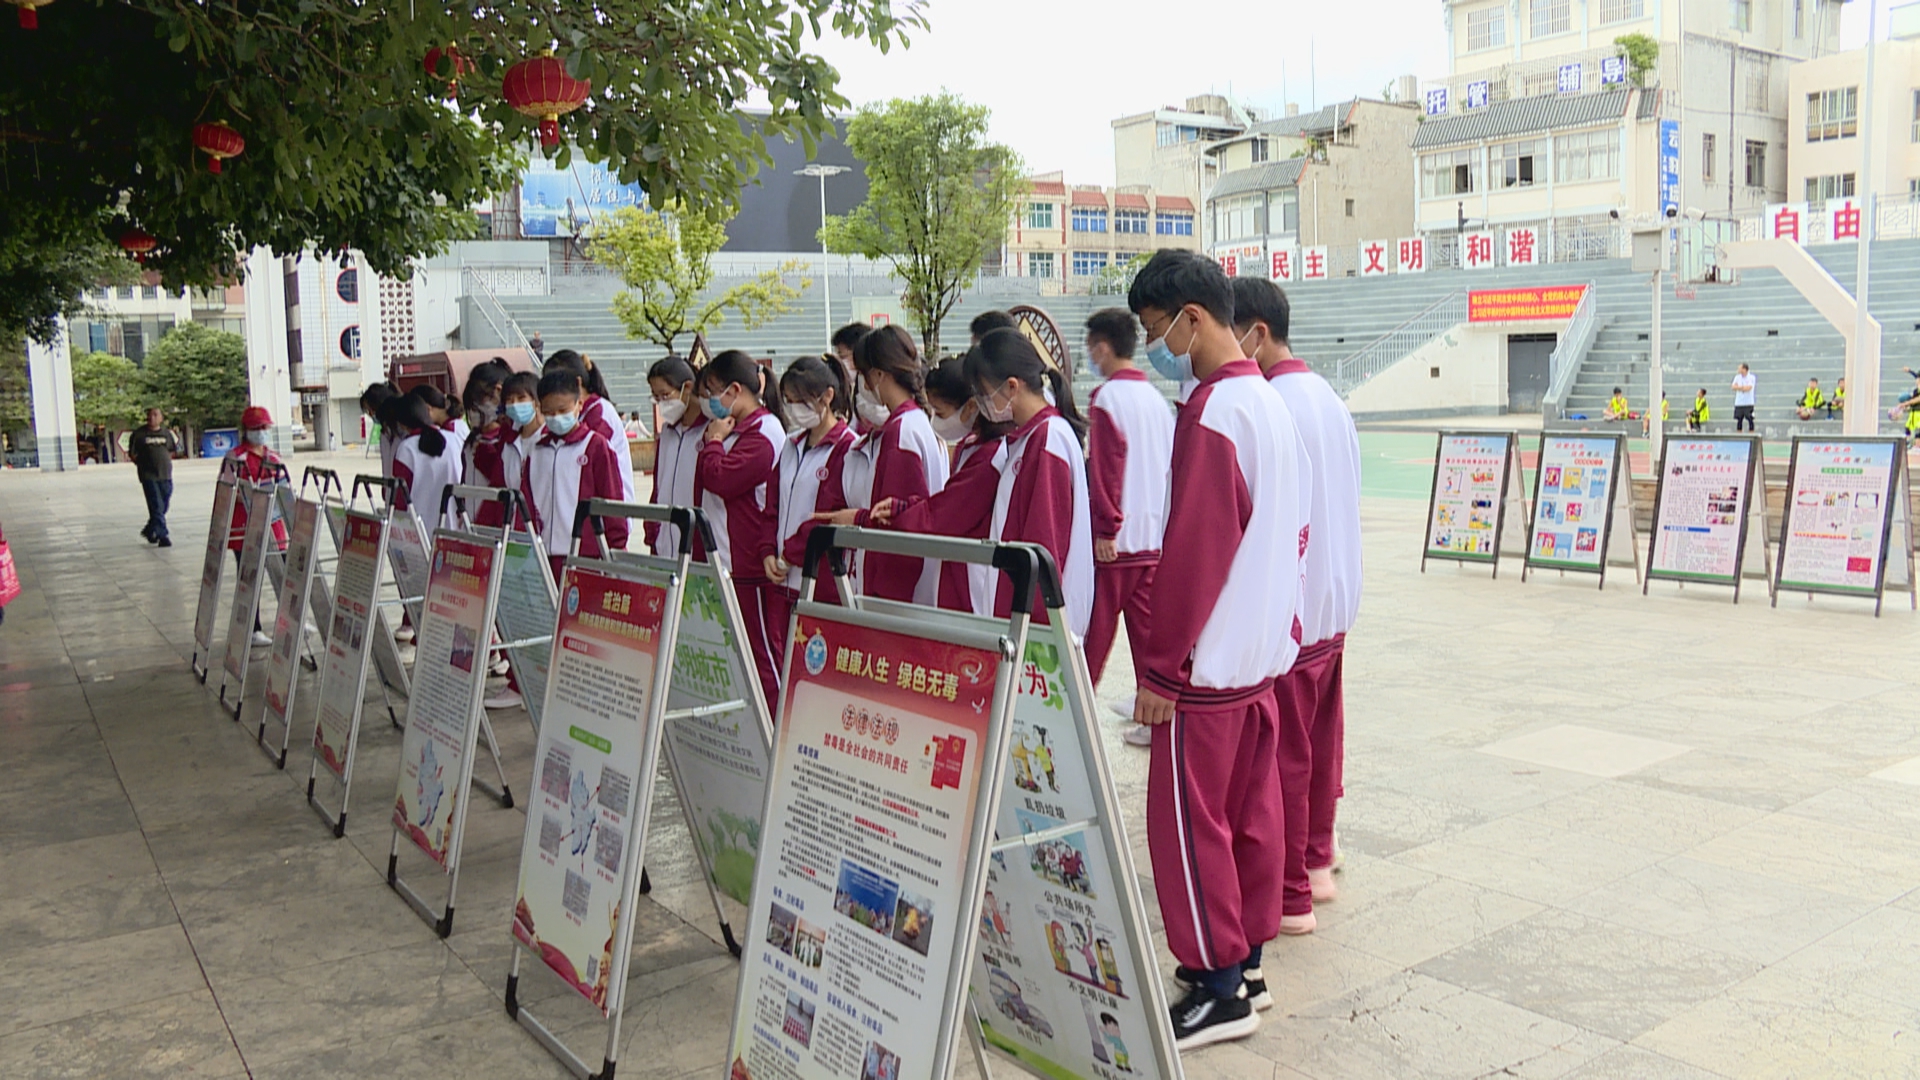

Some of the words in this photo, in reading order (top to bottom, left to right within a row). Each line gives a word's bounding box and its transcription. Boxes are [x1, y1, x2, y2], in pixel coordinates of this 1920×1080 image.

[1775, 201, 1860, 243] 自由
[1272, 250, 1325, 279] 民主
[1365, 237, 1422, 273] 文明
[1467, 229, 1534, 266] 和谐
[673, 644, 731, 688] 明城市
[835, 646, 890, 684] 健康人生
[896, 661, 960, 703] 绿色无毒
[842, 705, 899, 745] 法律法规
[823, 732, 909, 775] 禁毒是全社会的共同责任
[1024, 797, 1067, 821] 乱扔垃圾
[1067, 979, 1119, 1011] 不文明让座
